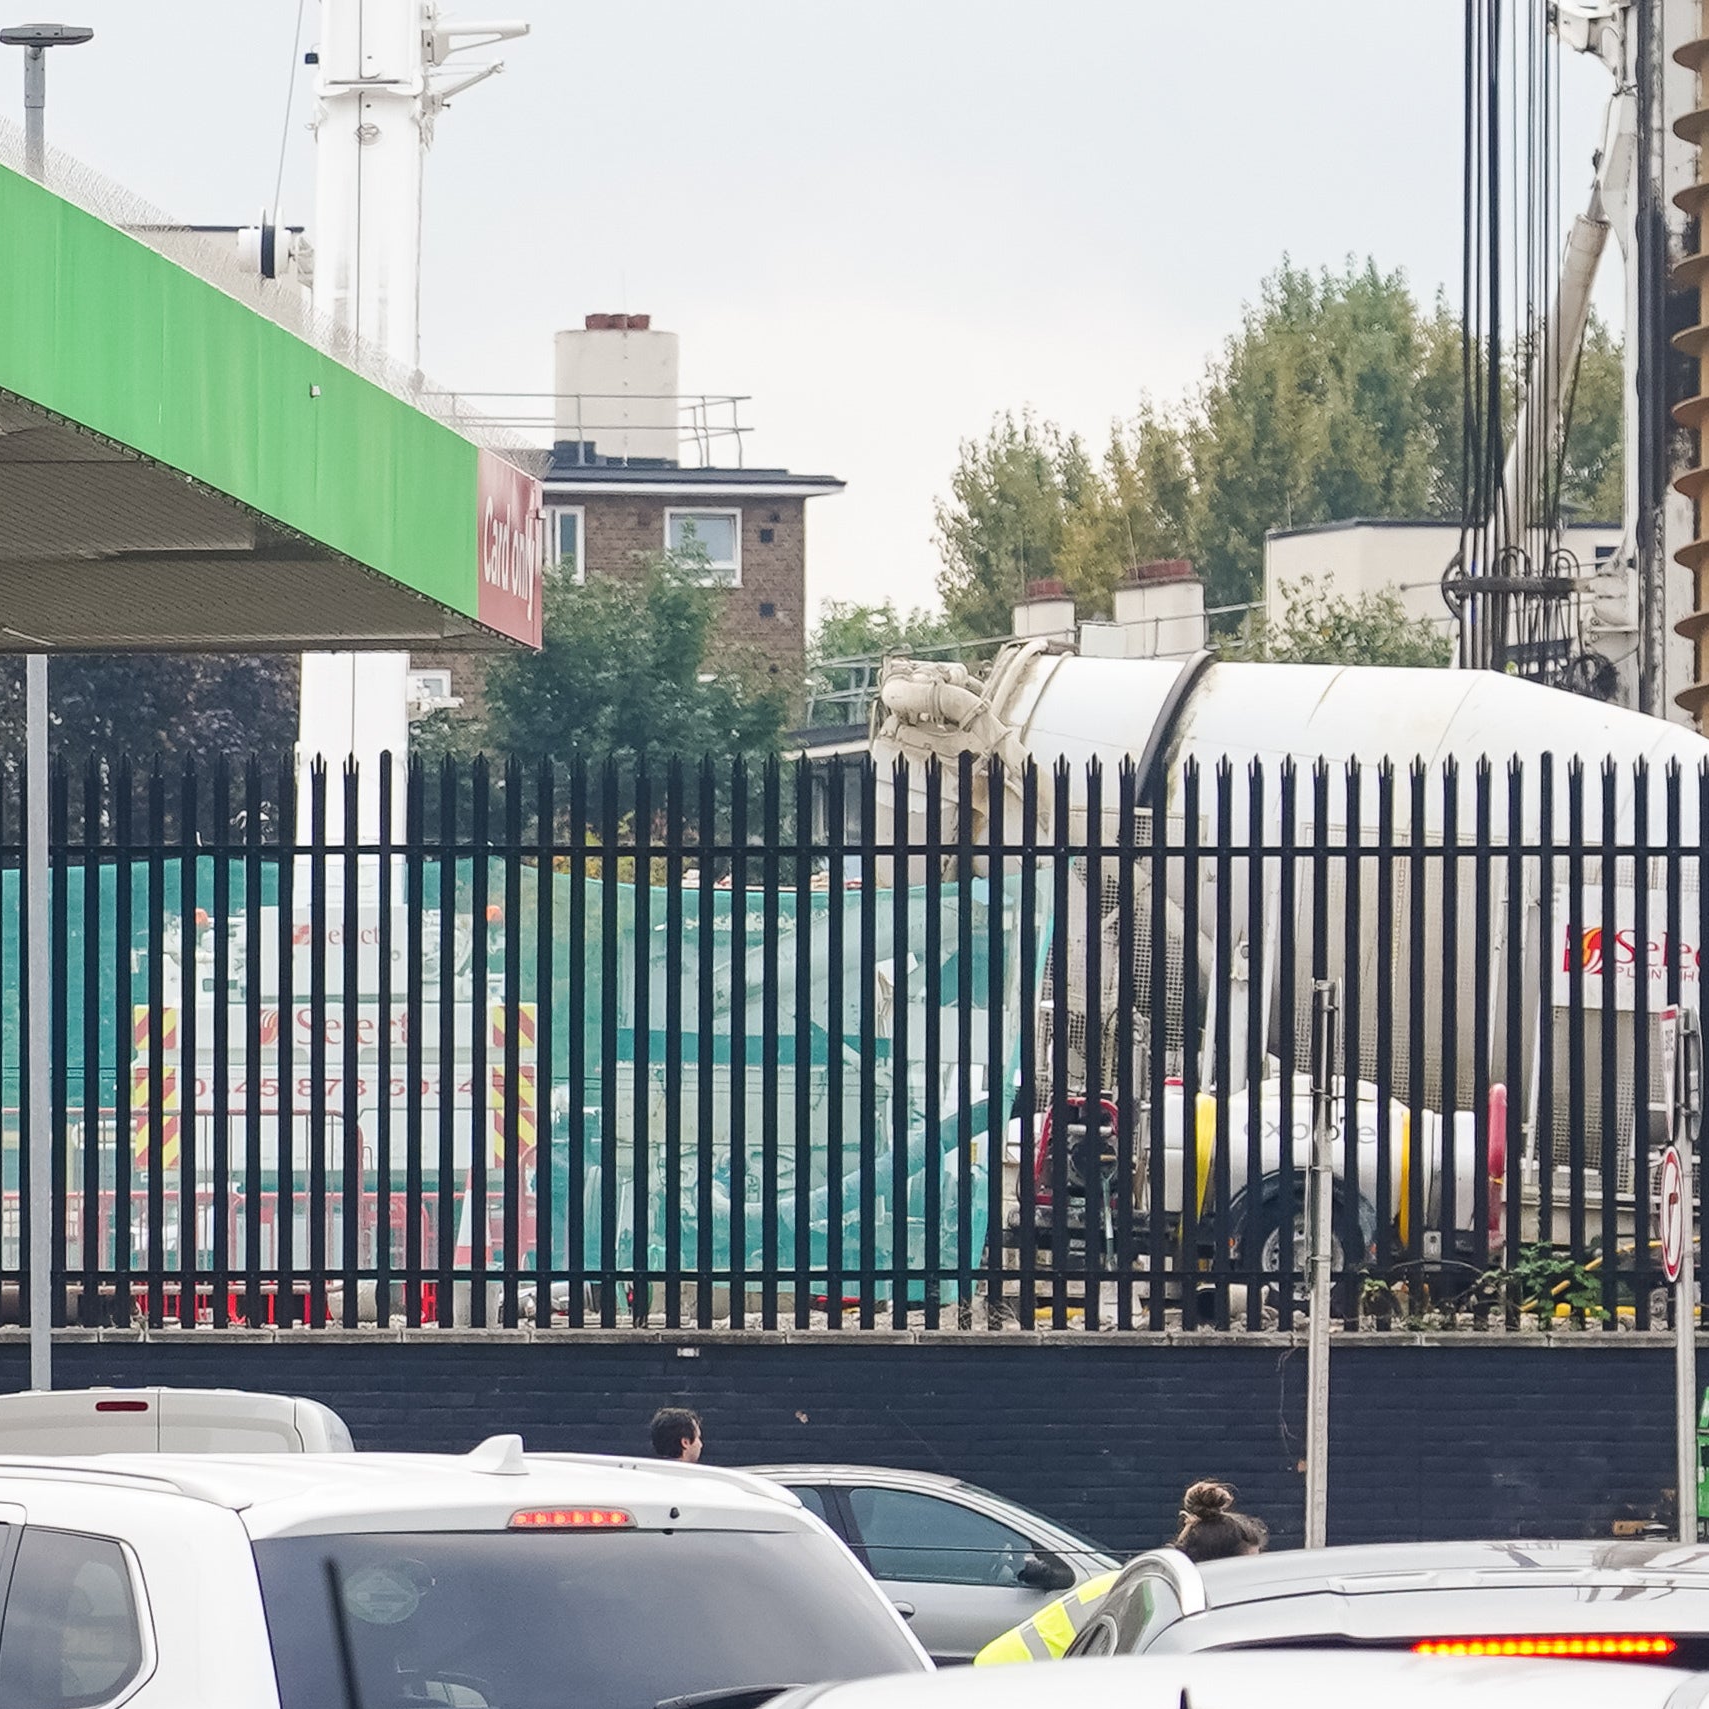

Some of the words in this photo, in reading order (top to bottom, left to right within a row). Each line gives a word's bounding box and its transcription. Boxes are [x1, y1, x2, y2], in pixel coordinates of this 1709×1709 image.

[484, 495, 510, 591] Card
[512, 513, 535, 621] only
[1614, 929, 1700, 969] Sele
[296, 1008, 409, 1045] Seet
